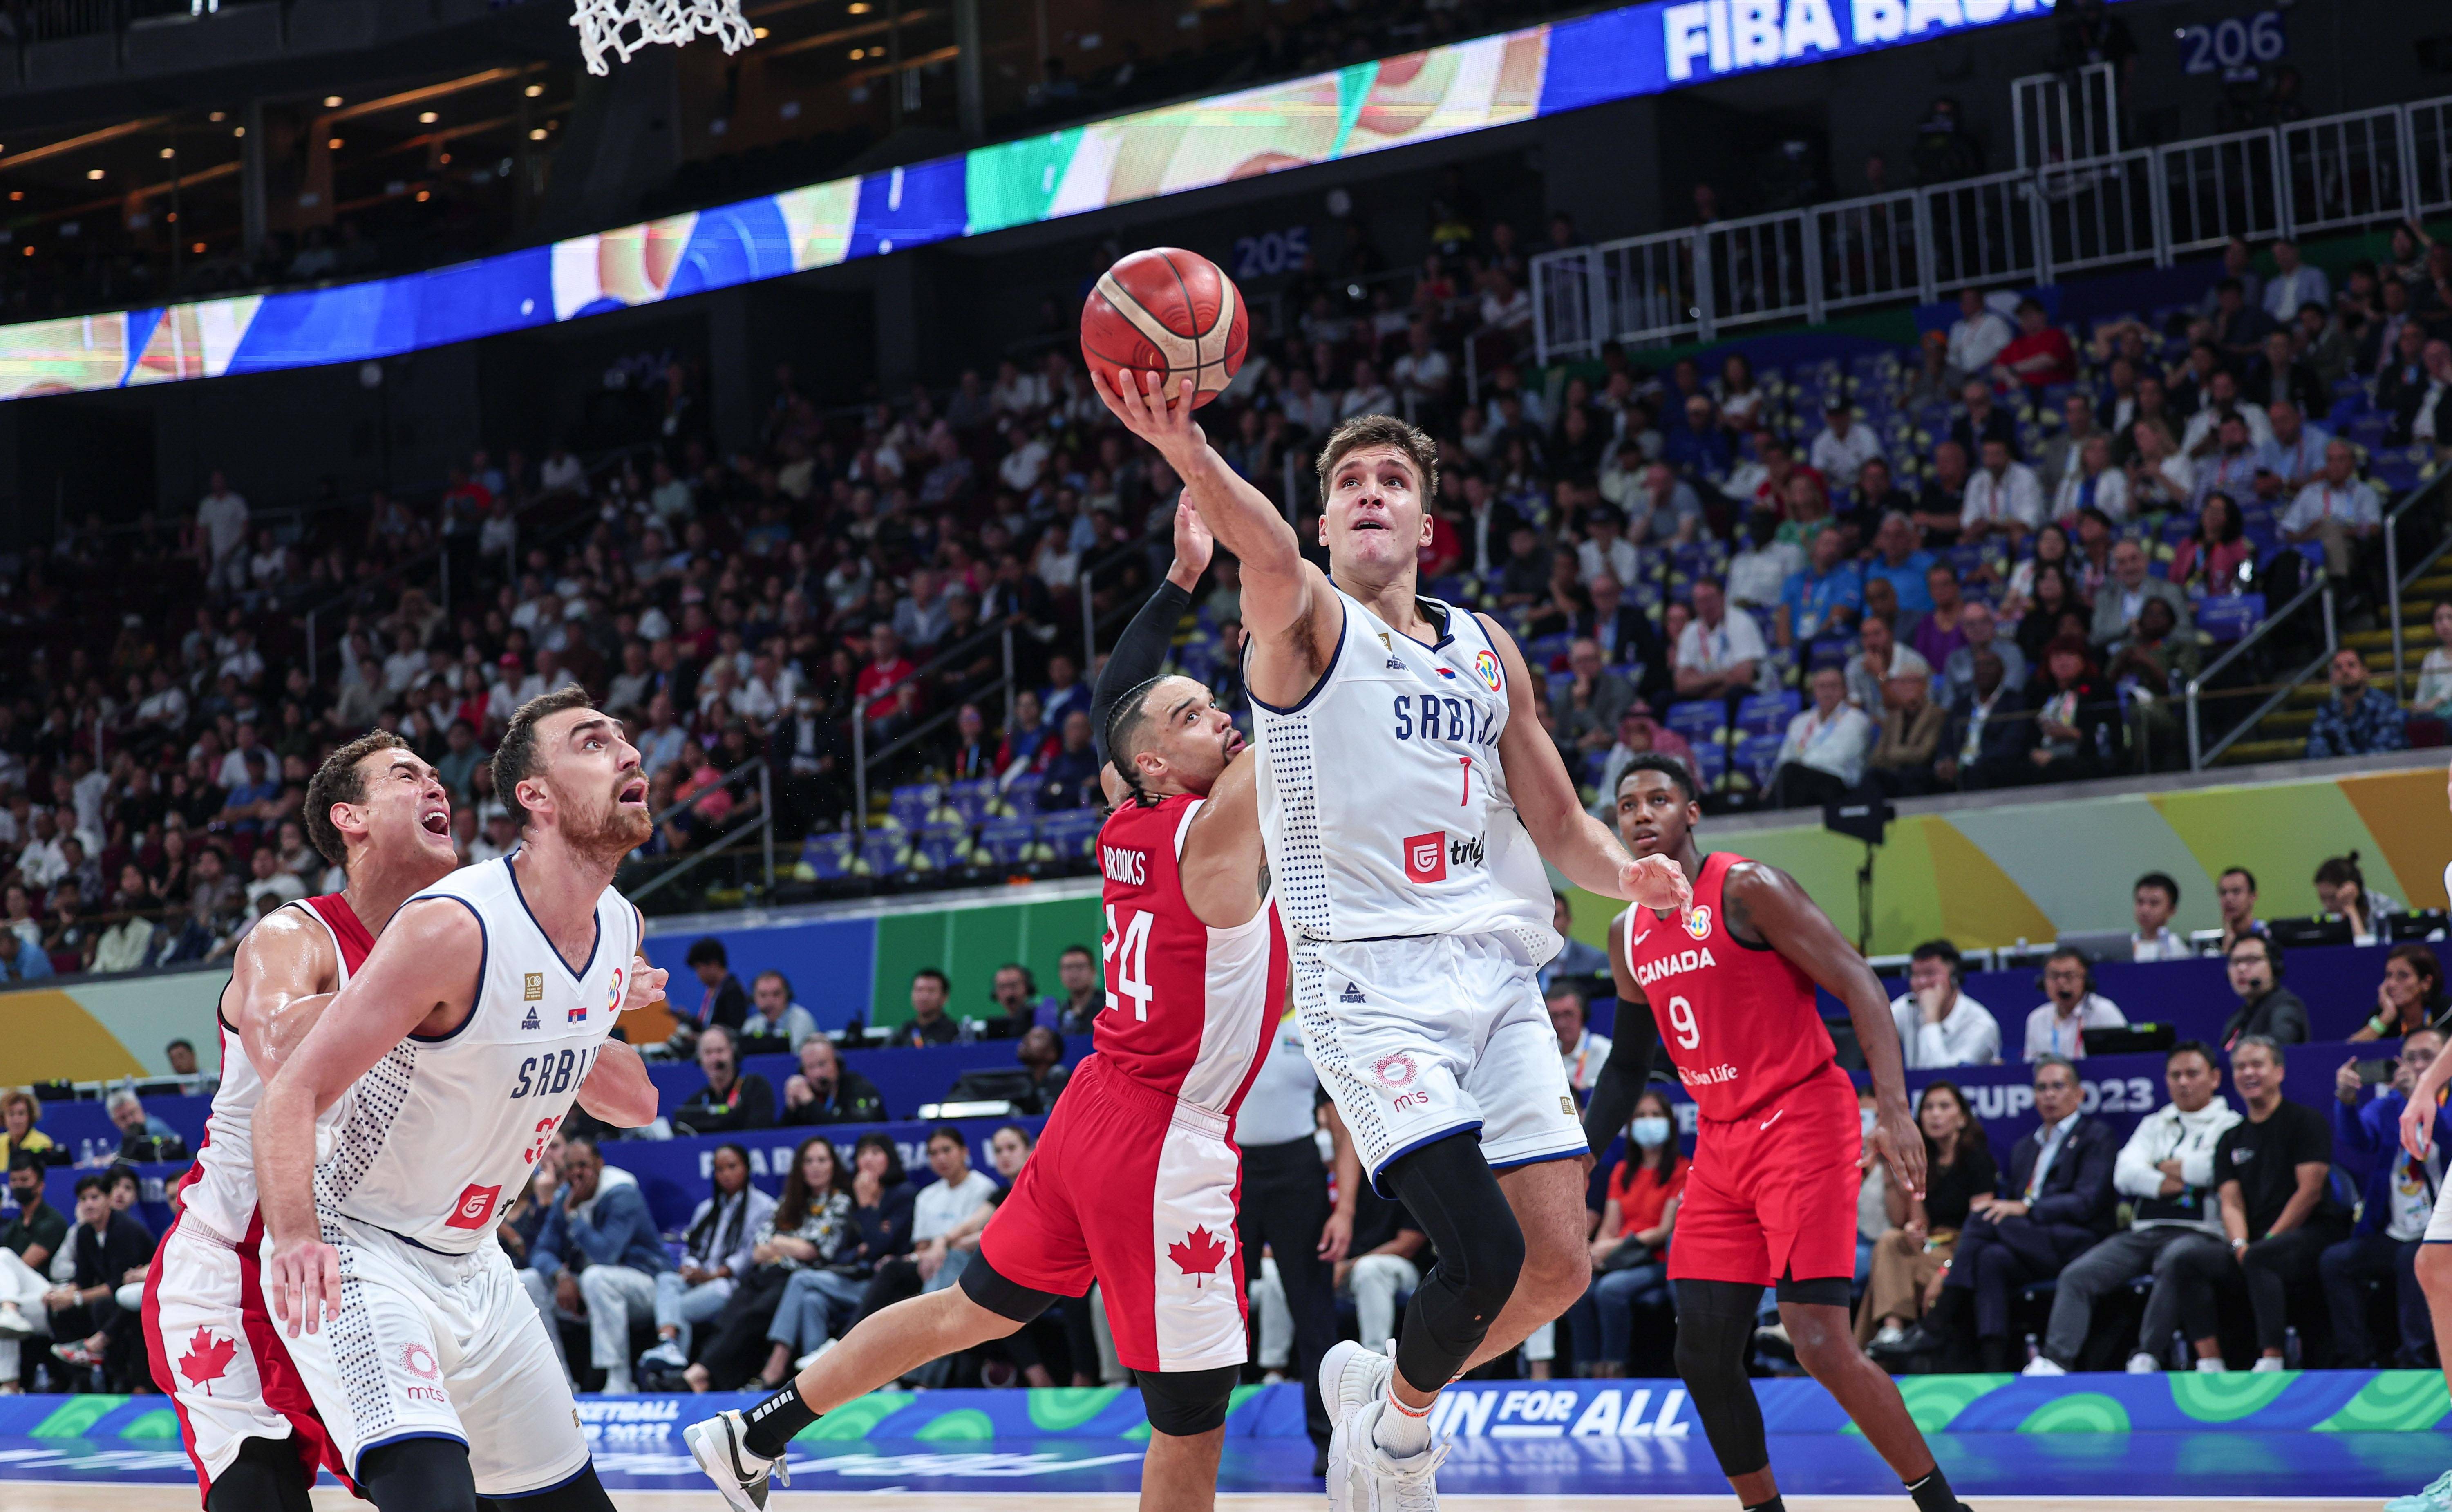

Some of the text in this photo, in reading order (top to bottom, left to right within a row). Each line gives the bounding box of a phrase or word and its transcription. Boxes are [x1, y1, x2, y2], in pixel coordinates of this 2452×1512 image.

[1662, 0, 1841, 81] FIBA
[2181, 11, 2284, 75] 206
[1235, 225, 1309, 280] 205
[1459, 756, 1472, 807] 7
[1103, 845, 1145, 886] BROOKS
[1450, 830, 1485, 868] trig
[1103, 904, 1154, 1022] 24
[1637, 947, 1716, 986] CANADA
[1340, 994, 1366, 1004] PEAK
[521, 1020, 541, 1030] PEAK
[1669, 995, 1701, 1050] 9
[510, 1043, 602, 1099] SRBI
[1690, 1063, 1739, 1086] Sun Life
[1393, 1091, 1428, 1113] mts
[2078, 1076, 2155, 1115] 023
[407, 1385, 445, 1402] mts
[1427, 1389, 1690, 1437] IN FOR ALL
